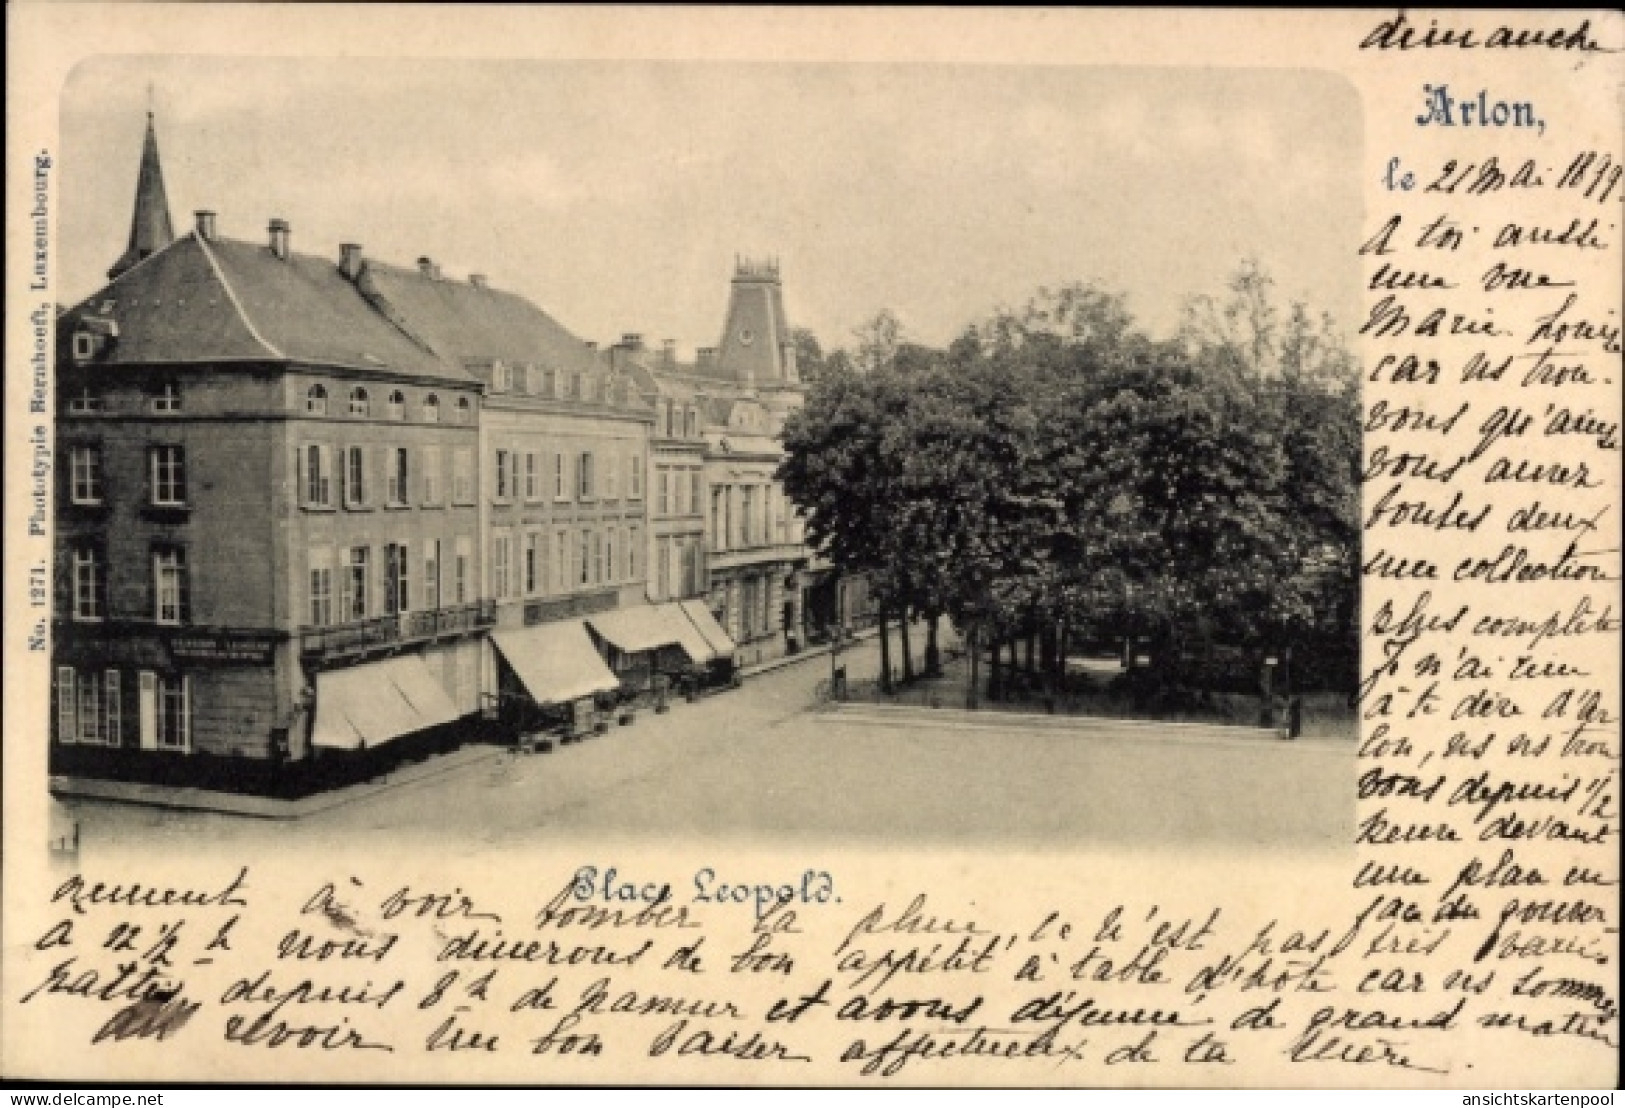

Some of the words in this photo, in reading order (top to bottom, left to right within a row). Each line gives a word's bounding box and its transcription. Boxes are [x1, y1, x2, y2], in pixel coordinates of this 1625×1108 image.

[1415, 83, 1546, 137] Arlon,
[1382, 156, 1416, 190] le
[29, 148, 51, 291] Luxembourg.
[29, 425, 50, 536] Phototypie
[30, 560, 46, 608] 1271.
[30, 618, 46, 651] No.
[692, 868, 843, 919] Leopold.
